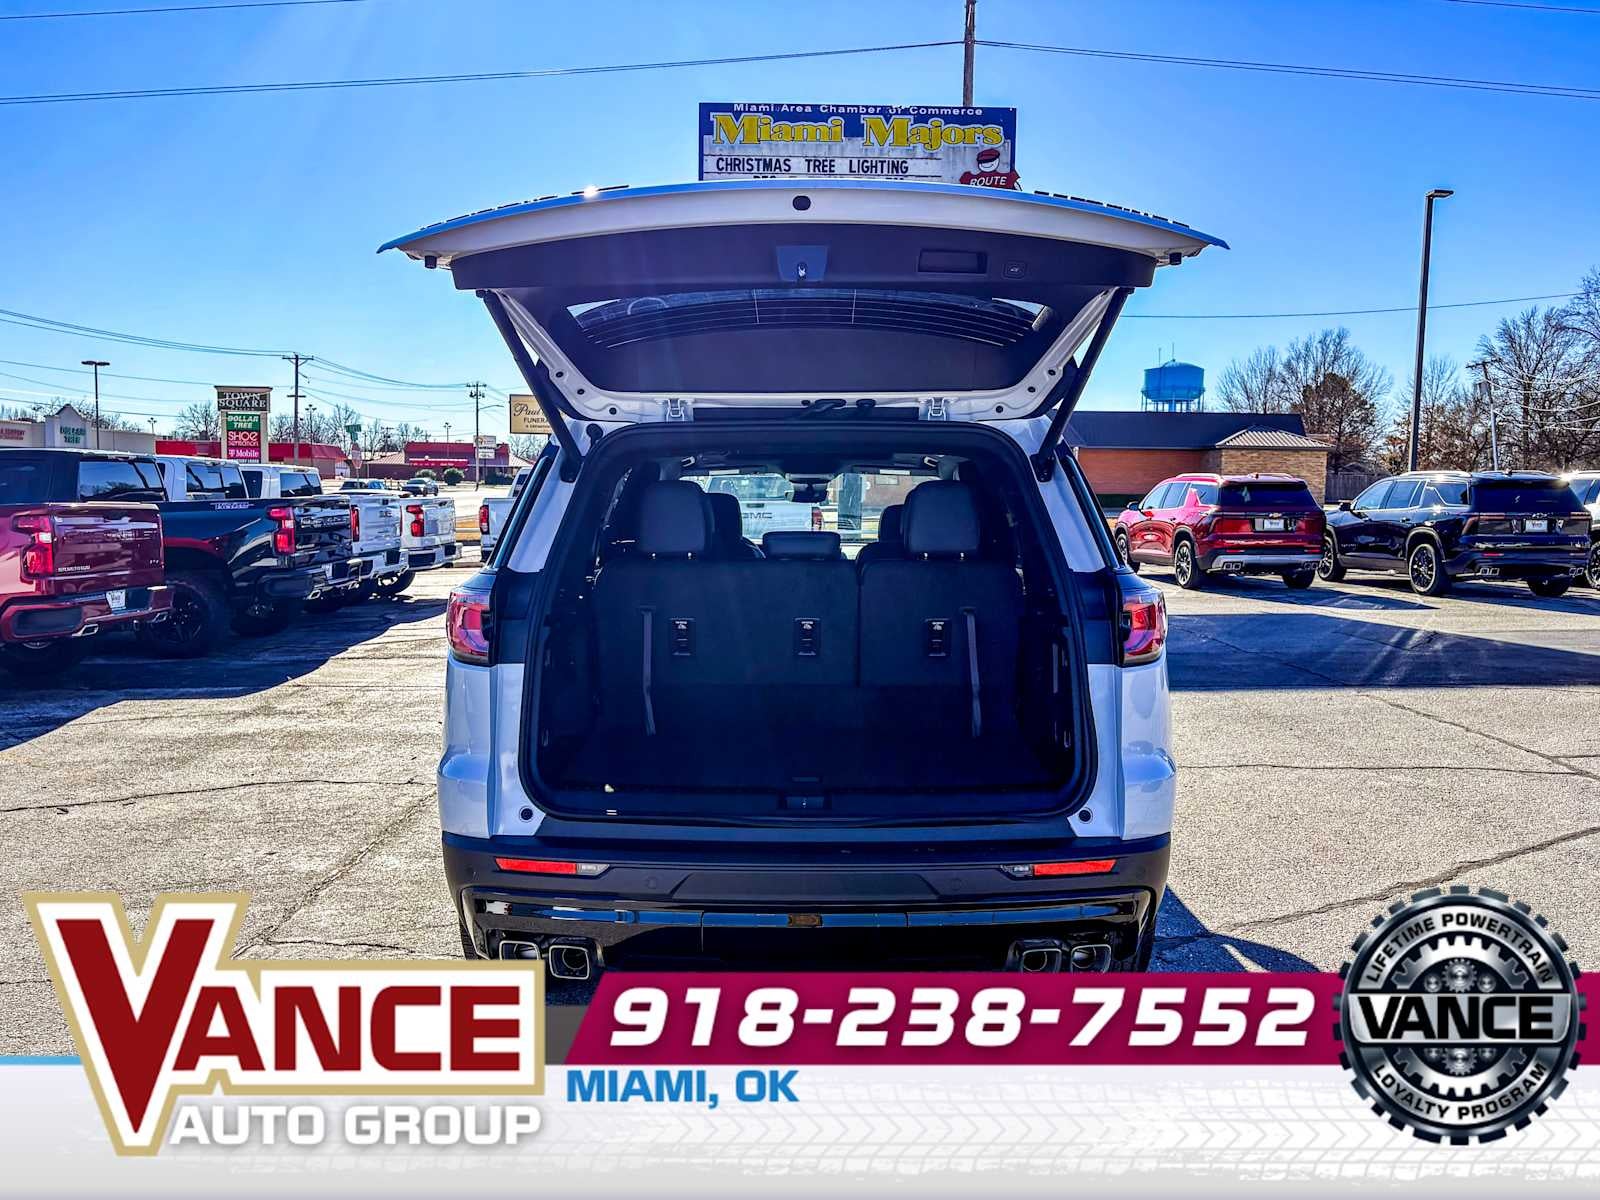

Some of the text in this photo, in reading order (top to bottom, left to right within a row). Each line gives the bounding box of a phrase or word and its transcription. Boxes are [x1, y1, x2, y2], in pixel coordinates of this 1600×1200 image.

[733, 103, 774, 112] Miami
[781, 104, 812, 112] Area
[819, 104, 882, 114] Chamber
[909, 107, 983, 116] Commerce
[712, 114, 1003, 151] Miami Majors
[716, 157, 909, 175] CHRISTMAS TREE LIGHTING
[969, 175, 1008, 187] ROUTE
[223, 392, 261, 400] TOWN
[218, 399, 266, 408] SQUARE
[236, 449, 259, 457] Mobile
